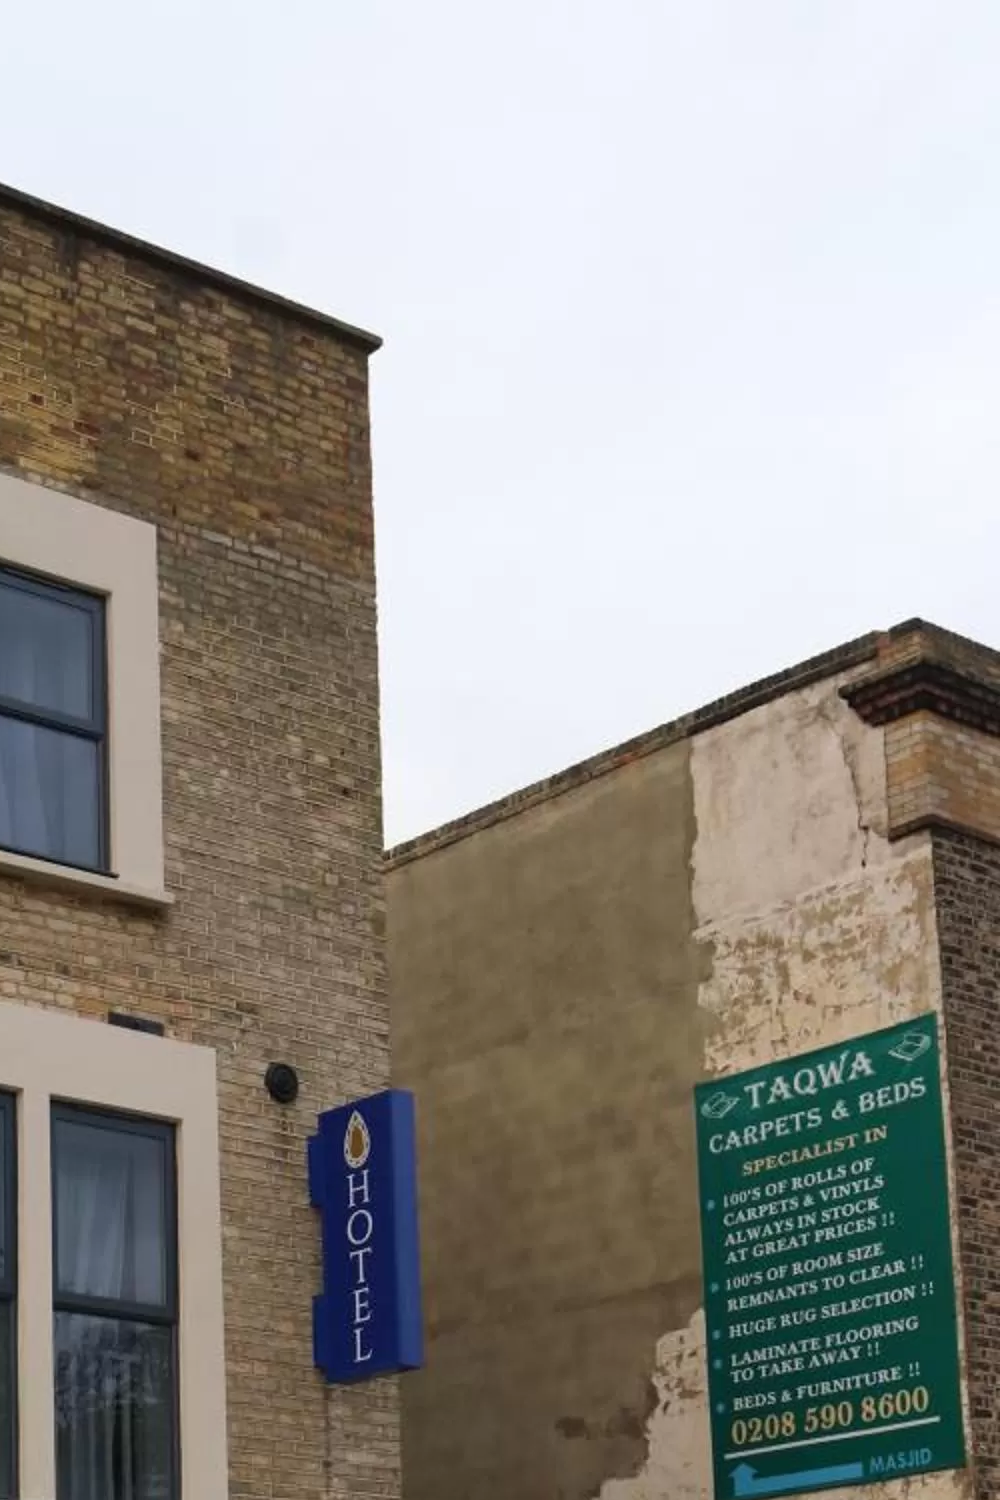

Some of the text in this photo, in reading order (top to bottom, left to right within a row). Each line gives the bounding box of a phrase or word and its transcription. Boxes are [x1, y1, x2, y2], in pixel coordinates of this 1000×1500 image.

[744, 1051, 876, 1109] TAQWA
[709, 1076, 927, 1153] CARPETS & BEDS
[742, 1125, 889, 1176] SPECIALIST IN
[723, 1157, 875, 1208] 100'S OF ROLLS OF
[723, 1175, 885, 1227] CARPETS & VINYLS
[724, 1197, 881, 1247] ALWAYS IN STOCK
[725, 1249, 749, 1265] AT
[753, 1231, 811, 1259] GREAT
[815, 1217, 877, 1243] PRICES
[346, 1169, 374, 1363] HOTEL
[725, 1243, 885, 1291] 100'S OF ROOM SIZE
[727, 1280, 818, 1313] REMNANTS
[822, 1273, 845, 1290] TO
[849, 1259, 906, 1285] CLEAR
[729, 1317, 776, 1339] HUGE
[781, 1308, 817, 1328] RUG
[821, 1285, 916, 1318] SELECTION
[731, 1316, 920, 1367] LAMINATE FLOORING
[731, 1367, 754, 1383] TO
[758, 1358, 805, 1377] TAKE
[808, 1345, 863, 1368] AWAY
[733, 1391, 777, 1411] BEDS
[781, 1388, 793, 1402] &
[797, 1366, 902, 1399] FURNITURE
[731, 1386, 929, 1445] 0208 590 8600
[869, 1448, 932, 1474] MASJID
